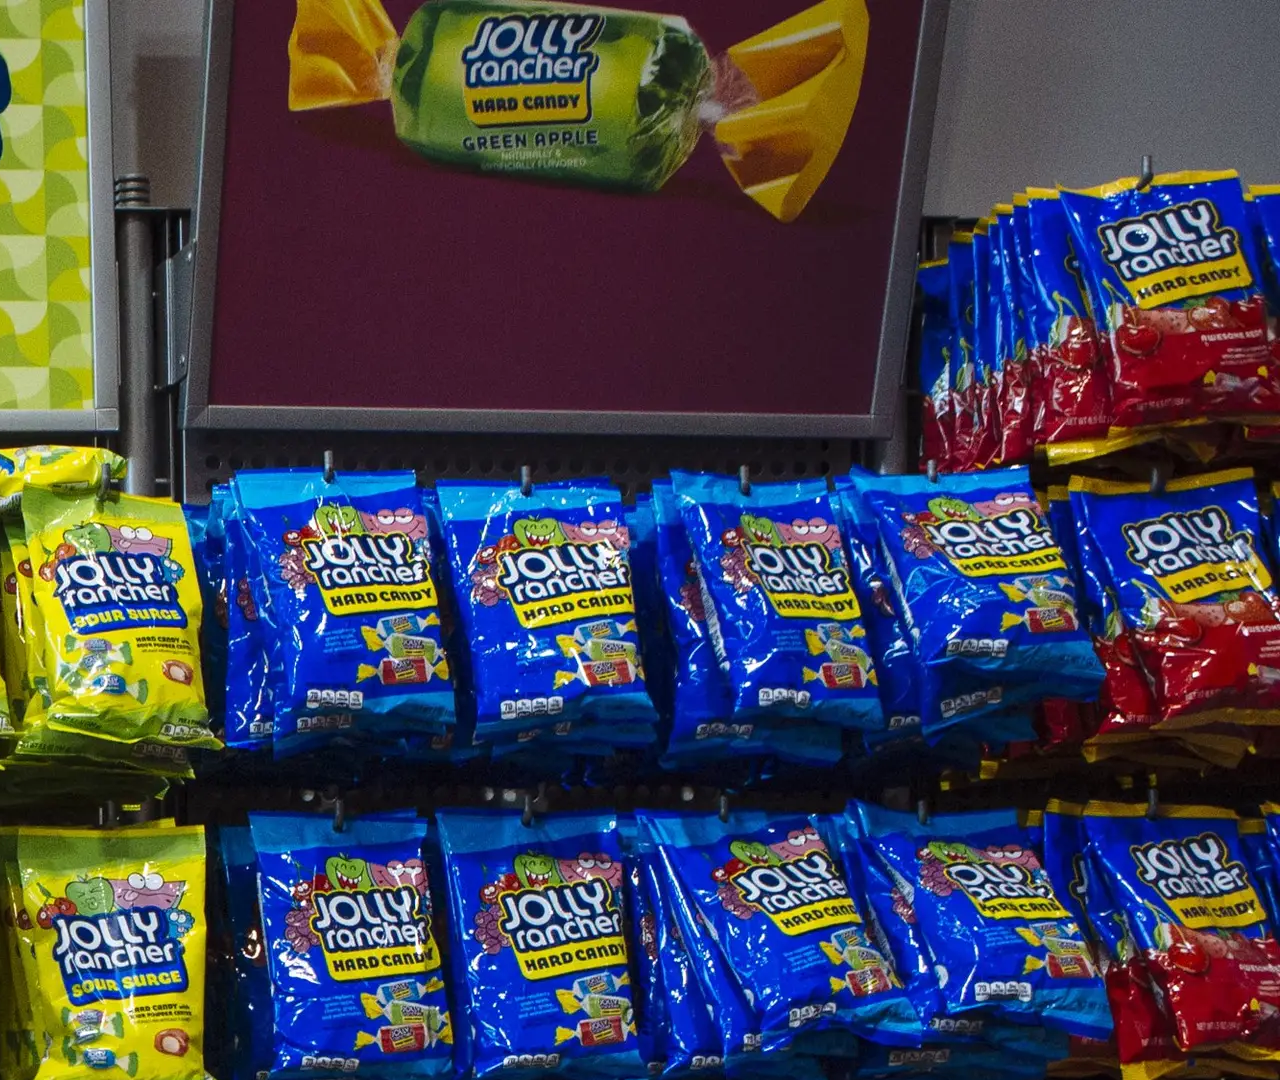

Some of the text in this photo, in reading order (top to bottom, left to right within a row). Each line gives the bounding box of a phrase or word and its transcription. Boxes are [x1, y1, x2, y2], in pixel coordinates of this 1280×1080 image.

[466, 18, 593, 60] JOLLY
[470, 53, 588, 84] rancher
[472, 94, 580, 113] HARD CANDY
[463, 130, 598, 151] GREEN APPLE
[1105, 205, 1211, 262] JOLLY
[1119, 233, 1232, 279] rancher
[1138, 266, 1241, 300] HARD CANDY
[307, 537, 404, 569] JOLLY
[322, 563, 424, 587] rancher
[330, 588, 432, 608] HARD CANDY
[505, 882, 605, 931] JOLLY
[516, 913, 621, 949] rancher
[525, 944, 625, 971] HARD CANDY
